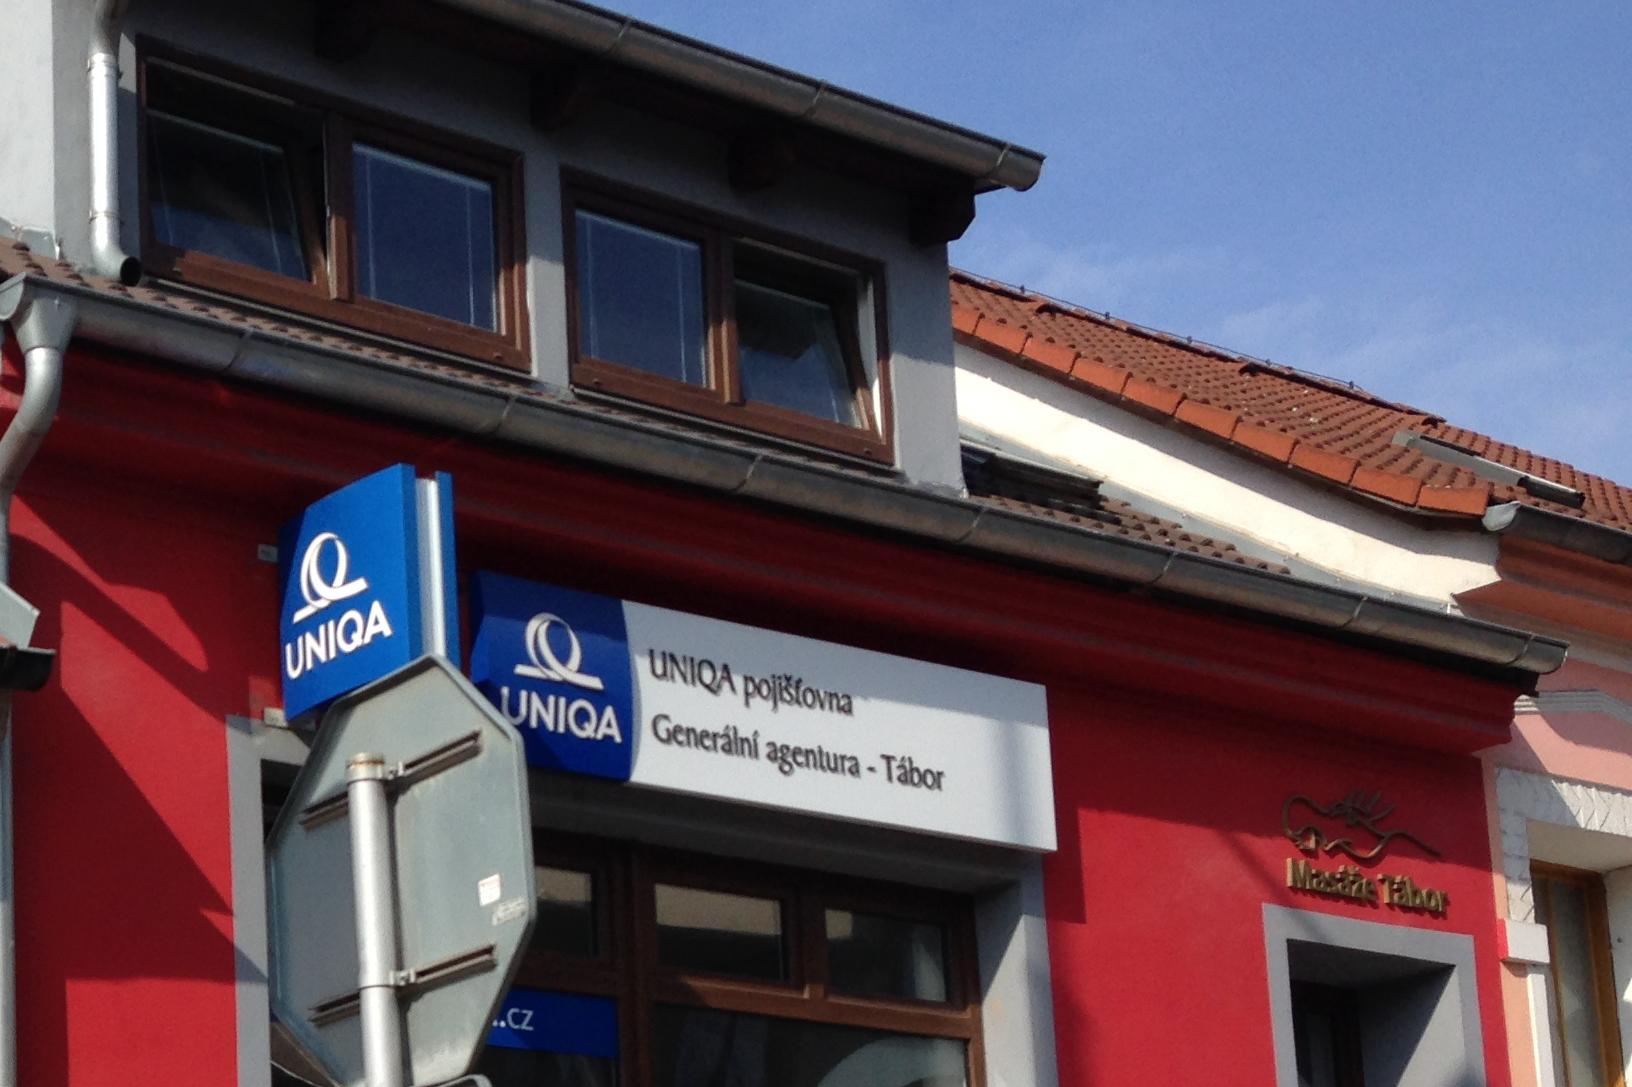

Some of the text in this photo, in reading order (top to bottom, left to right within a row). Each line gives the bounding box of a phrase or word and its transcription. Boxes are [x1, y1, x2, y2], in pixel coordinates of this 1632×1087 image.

[285, 600, 393, 680] UNIQA
[649, 649, 736, 696] UNIQA
[501, 686, 622, 744] UNIQA
[652, 713, 759, 761] Generální
[766, 741, 861, 777] agentura
[881, 753, 945, 791] Tábor
[493, 1008, 534, 1031] .cz
